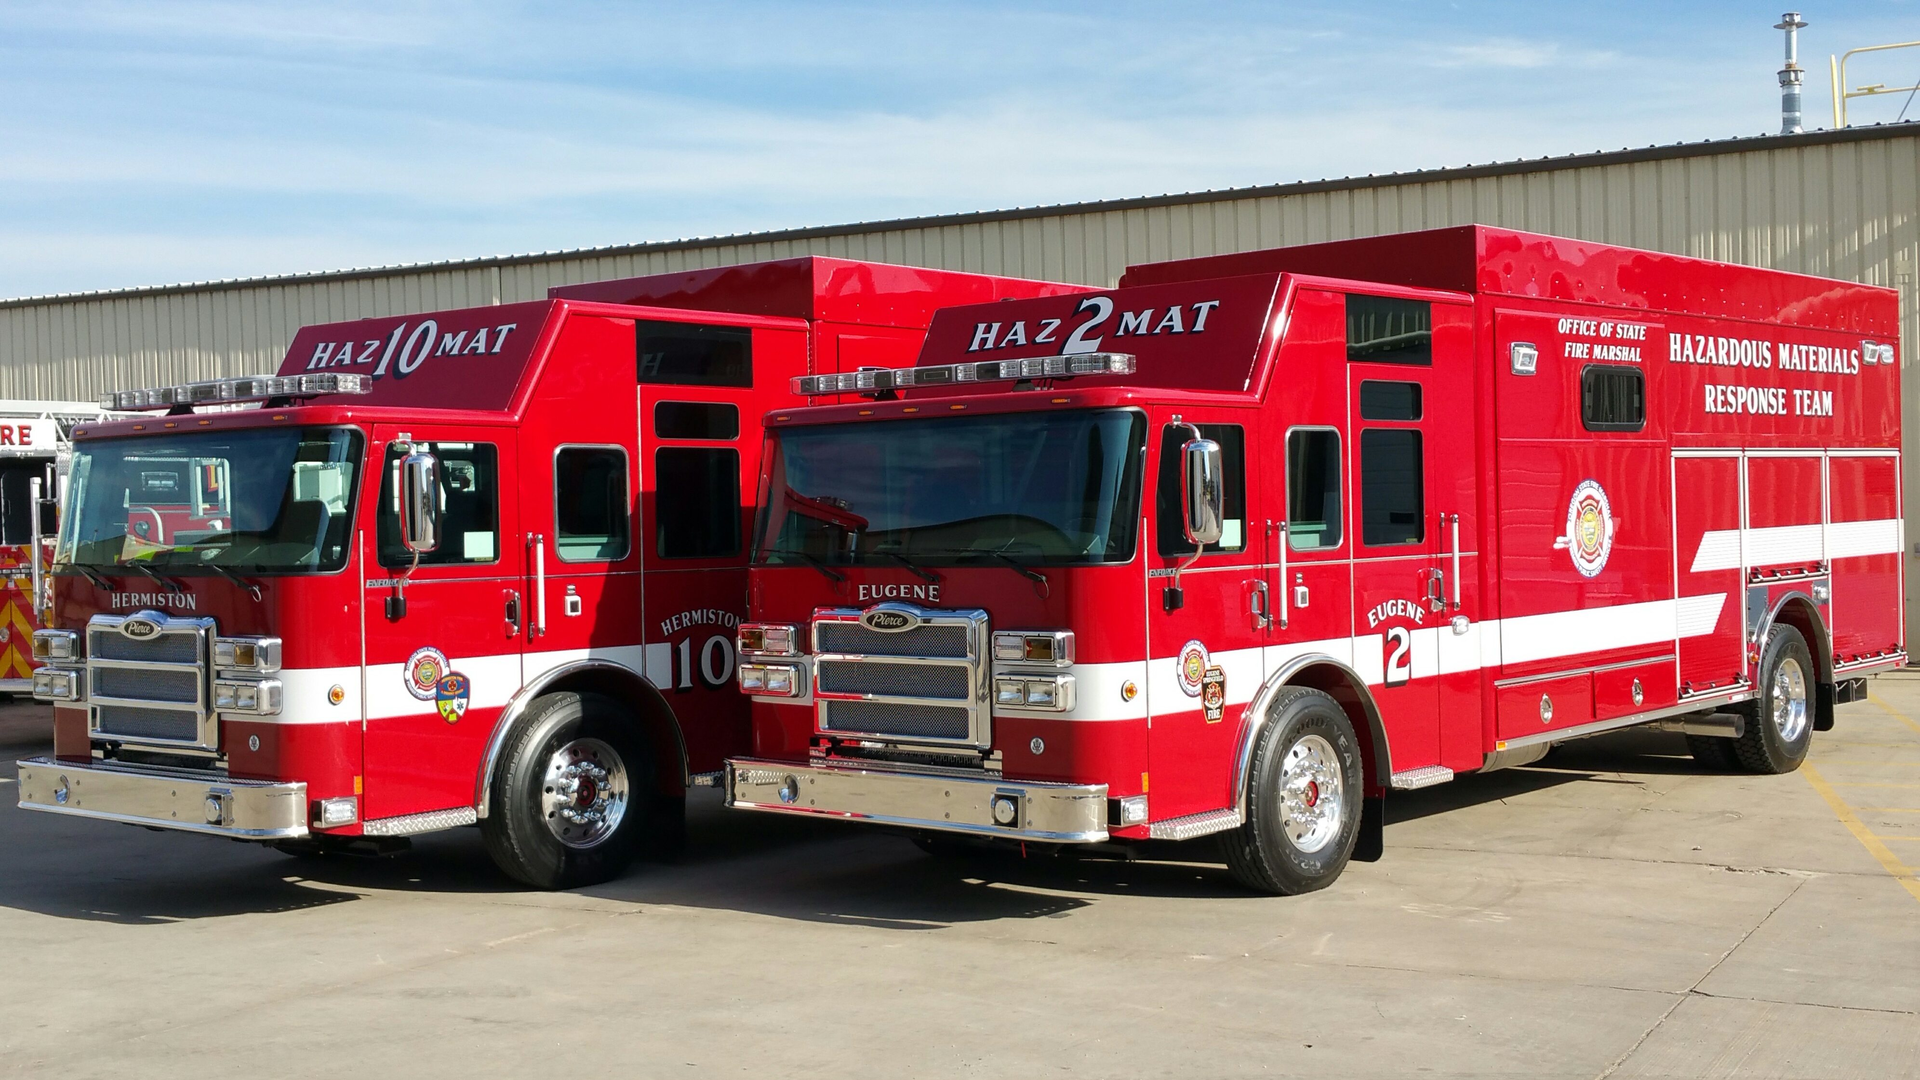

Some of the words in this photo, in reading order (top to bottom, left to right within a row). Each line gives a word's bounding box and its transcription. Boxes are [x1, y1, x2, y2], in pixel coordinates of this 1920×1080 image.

[968, 318, 1062, 352] HAZ
[1060, 296, 1114, 355] 2
[1115, 300, 1220, 337] MAT
[1558, 318, 1597, 336] OFFICE
[1599, 322, 1614, 338] OF
[1616, 323, 1647, 340] STATE
[307, 340, 380, 371] HAZ
[372, 319, 438, 377] 10
[434, 323, 517, 357] MAT
[1564, 342, 1590, 359] FIRE
[1593, 345, 1642, 362] MARSHAL
[1669, 333, 1771, 368] HAZARDOUS
[1779, 343, 1859, 374] MATERIALS
[1705, 385, 1787, 415] RESPONSE
[1794, 389, 1834, 416] TEAM
[112, 593, 196, 610] HERMISTON
[859, 585, 940, 602] EUGENE
[128, 621, 151, 634] Pierce
[661, 609, 744, 637] HERMISTON
[871, 614, 904, 627] Pierce
[1367, 599, 1425, 629] EUGENE
[677, 635, 735, 688] 10
[1386, 626, 1411, 685] 2
[1208, 709, 1221, 720] FIRE
